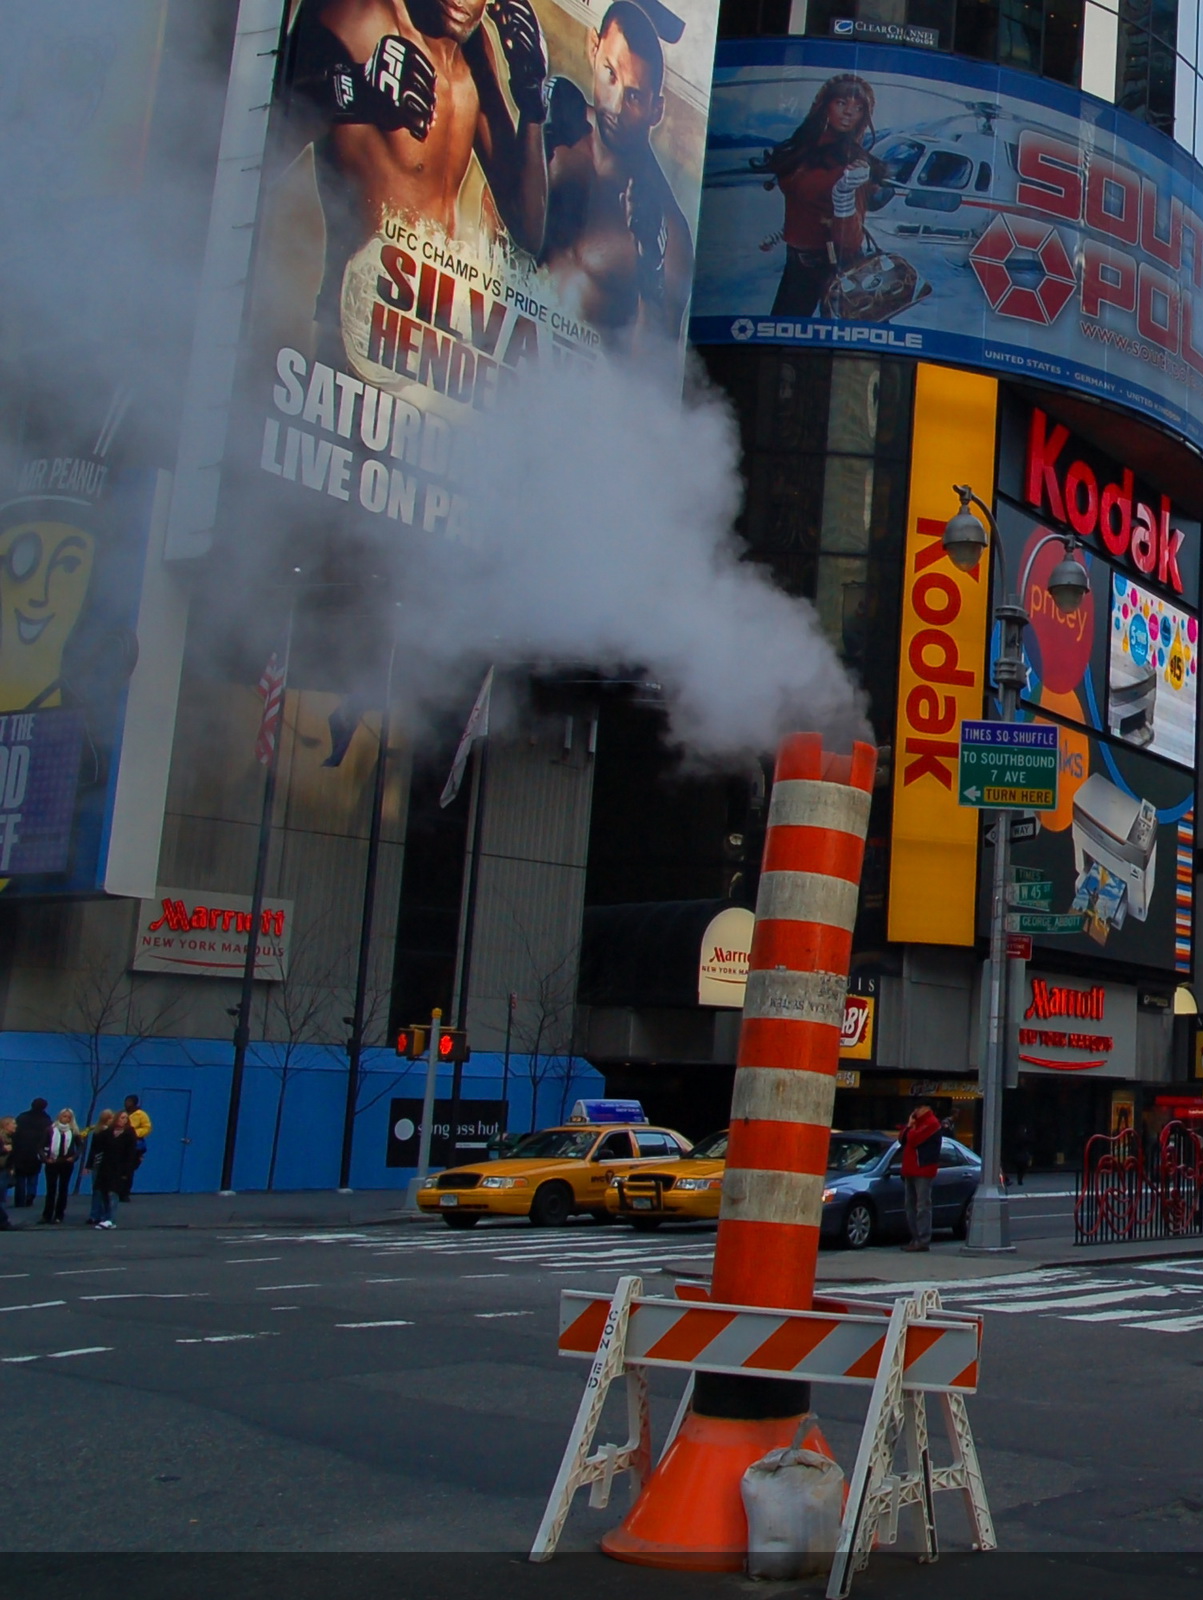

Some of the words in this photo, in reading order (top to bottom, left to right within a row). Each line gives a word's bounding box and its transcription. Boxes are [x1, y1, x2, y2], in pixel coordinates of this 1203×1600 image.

[855, 21, 935, 40] CLEARCHNNEL
[384, 219, 418, 251] UFC
[422, 241, 479, 282] CHAMP
[481, 272, 501, 297] VS
[504, 285, 549, 323] PRIDE
[550, 311, 600, 346] CHAMP
[376, 243, 540, 369] SILVA
[756, 323, 922, 349] SOUTHPOLE
[985, 350, 1024, 364] UNITED
[1026, 358, 1062, 375] STATES
[48, 457, 108, 499] PEANUT
[260, 417, 354, 502] LIVE
[359, 458, 417, 526] ON
[1023, 407, 1185, 594] Kodak
[902, 517, 980, 790] Kodak
[11, 713, 36, 741] THE
[964, 727, 992, 741] TIMES
[1013, 731, 1054, 745] SHUFFLE
[963, 751, 977, 764] TO
[981, 752, 1055, 769] SOUTHBOUND
[991, 769, 998, 782] 7
[1004, 770, 1026, 783] AVE
[986, 788, 1016, 802] TURN
[1022, 790, 1051, 803] HERE
[1031, 885, 1041, 899] 45
[1022, 915, 1051, 926] GEORGE
[1054, 914, 1081, 927] ABBOTT
[142, 936, 175, 947] NEW
[179, 937, 217, 951] YORK
[701, 965, 717, 973] NEW
[719, 966, 737, 975] YORK
[1024, 978, 1105, 1021] Marriott
[477, 1120, 499, 1135] hut
